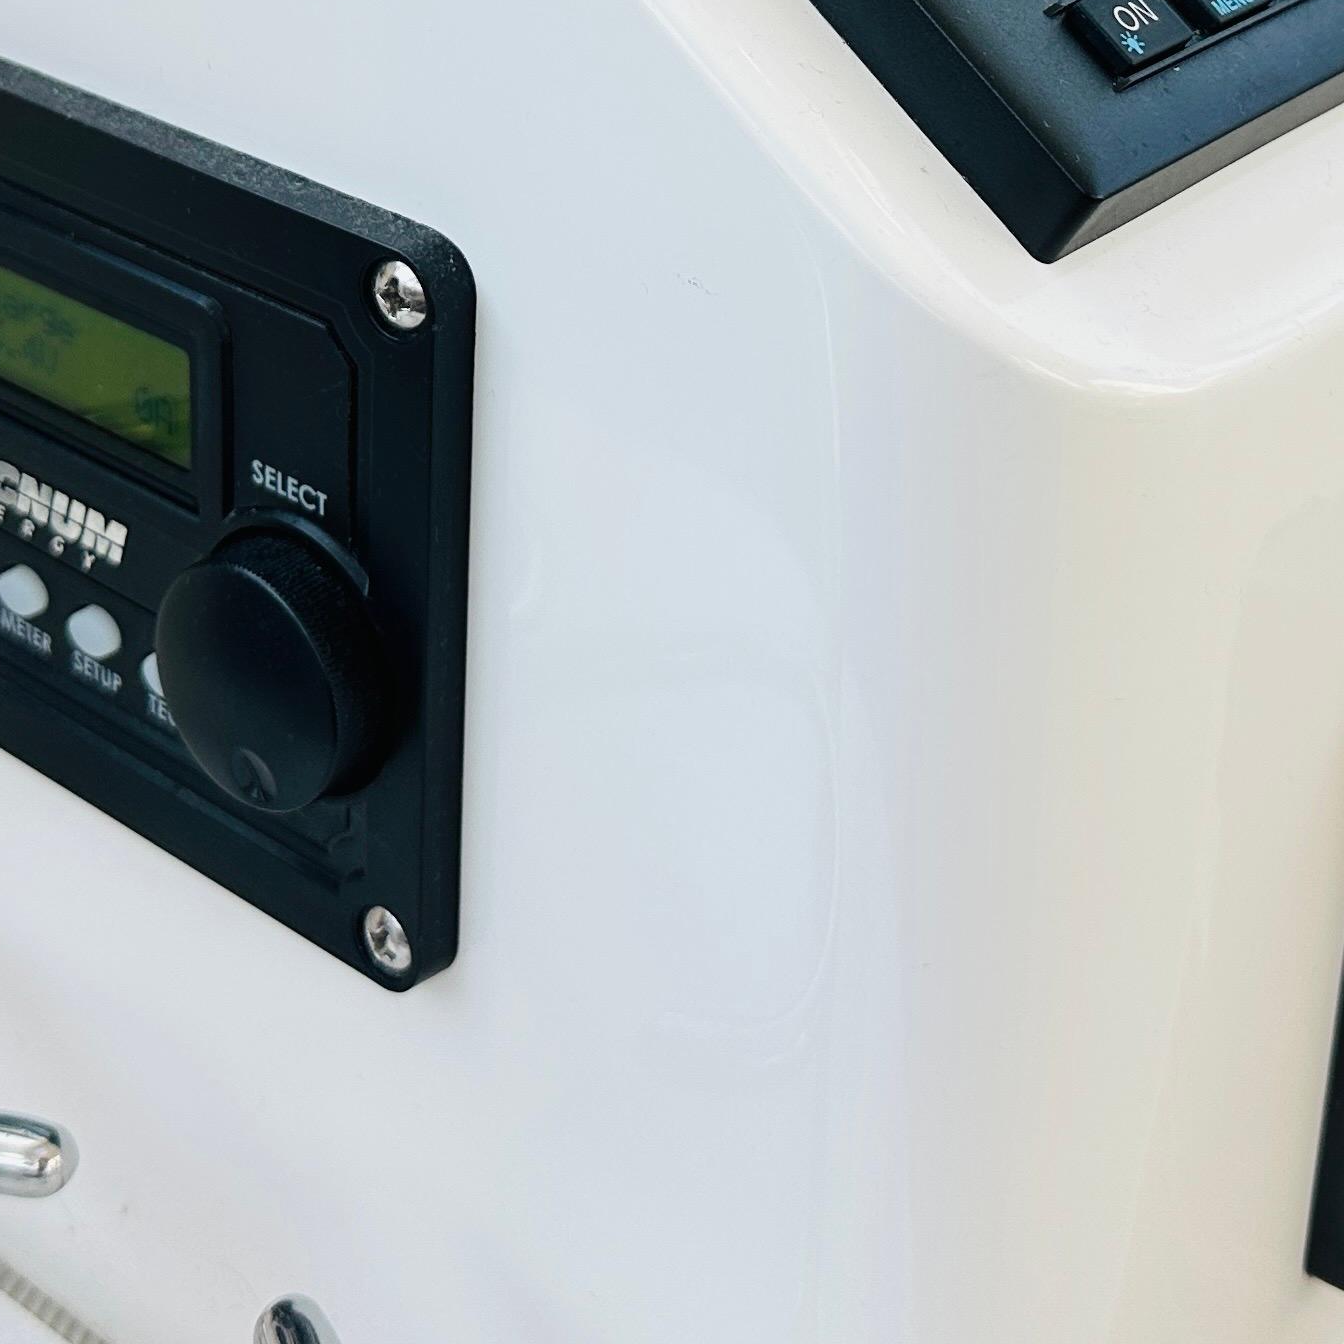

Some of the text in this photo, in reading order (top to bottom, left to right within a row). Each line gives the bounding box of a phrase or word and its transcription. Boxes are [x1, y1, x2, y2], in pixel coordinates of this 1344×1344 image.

[252, 459, 327, 516] SELECT
[0, 608, 52, 654] METER
[71, 649, 122, 694] SETUP
[148, 693, 176, 726] TE
